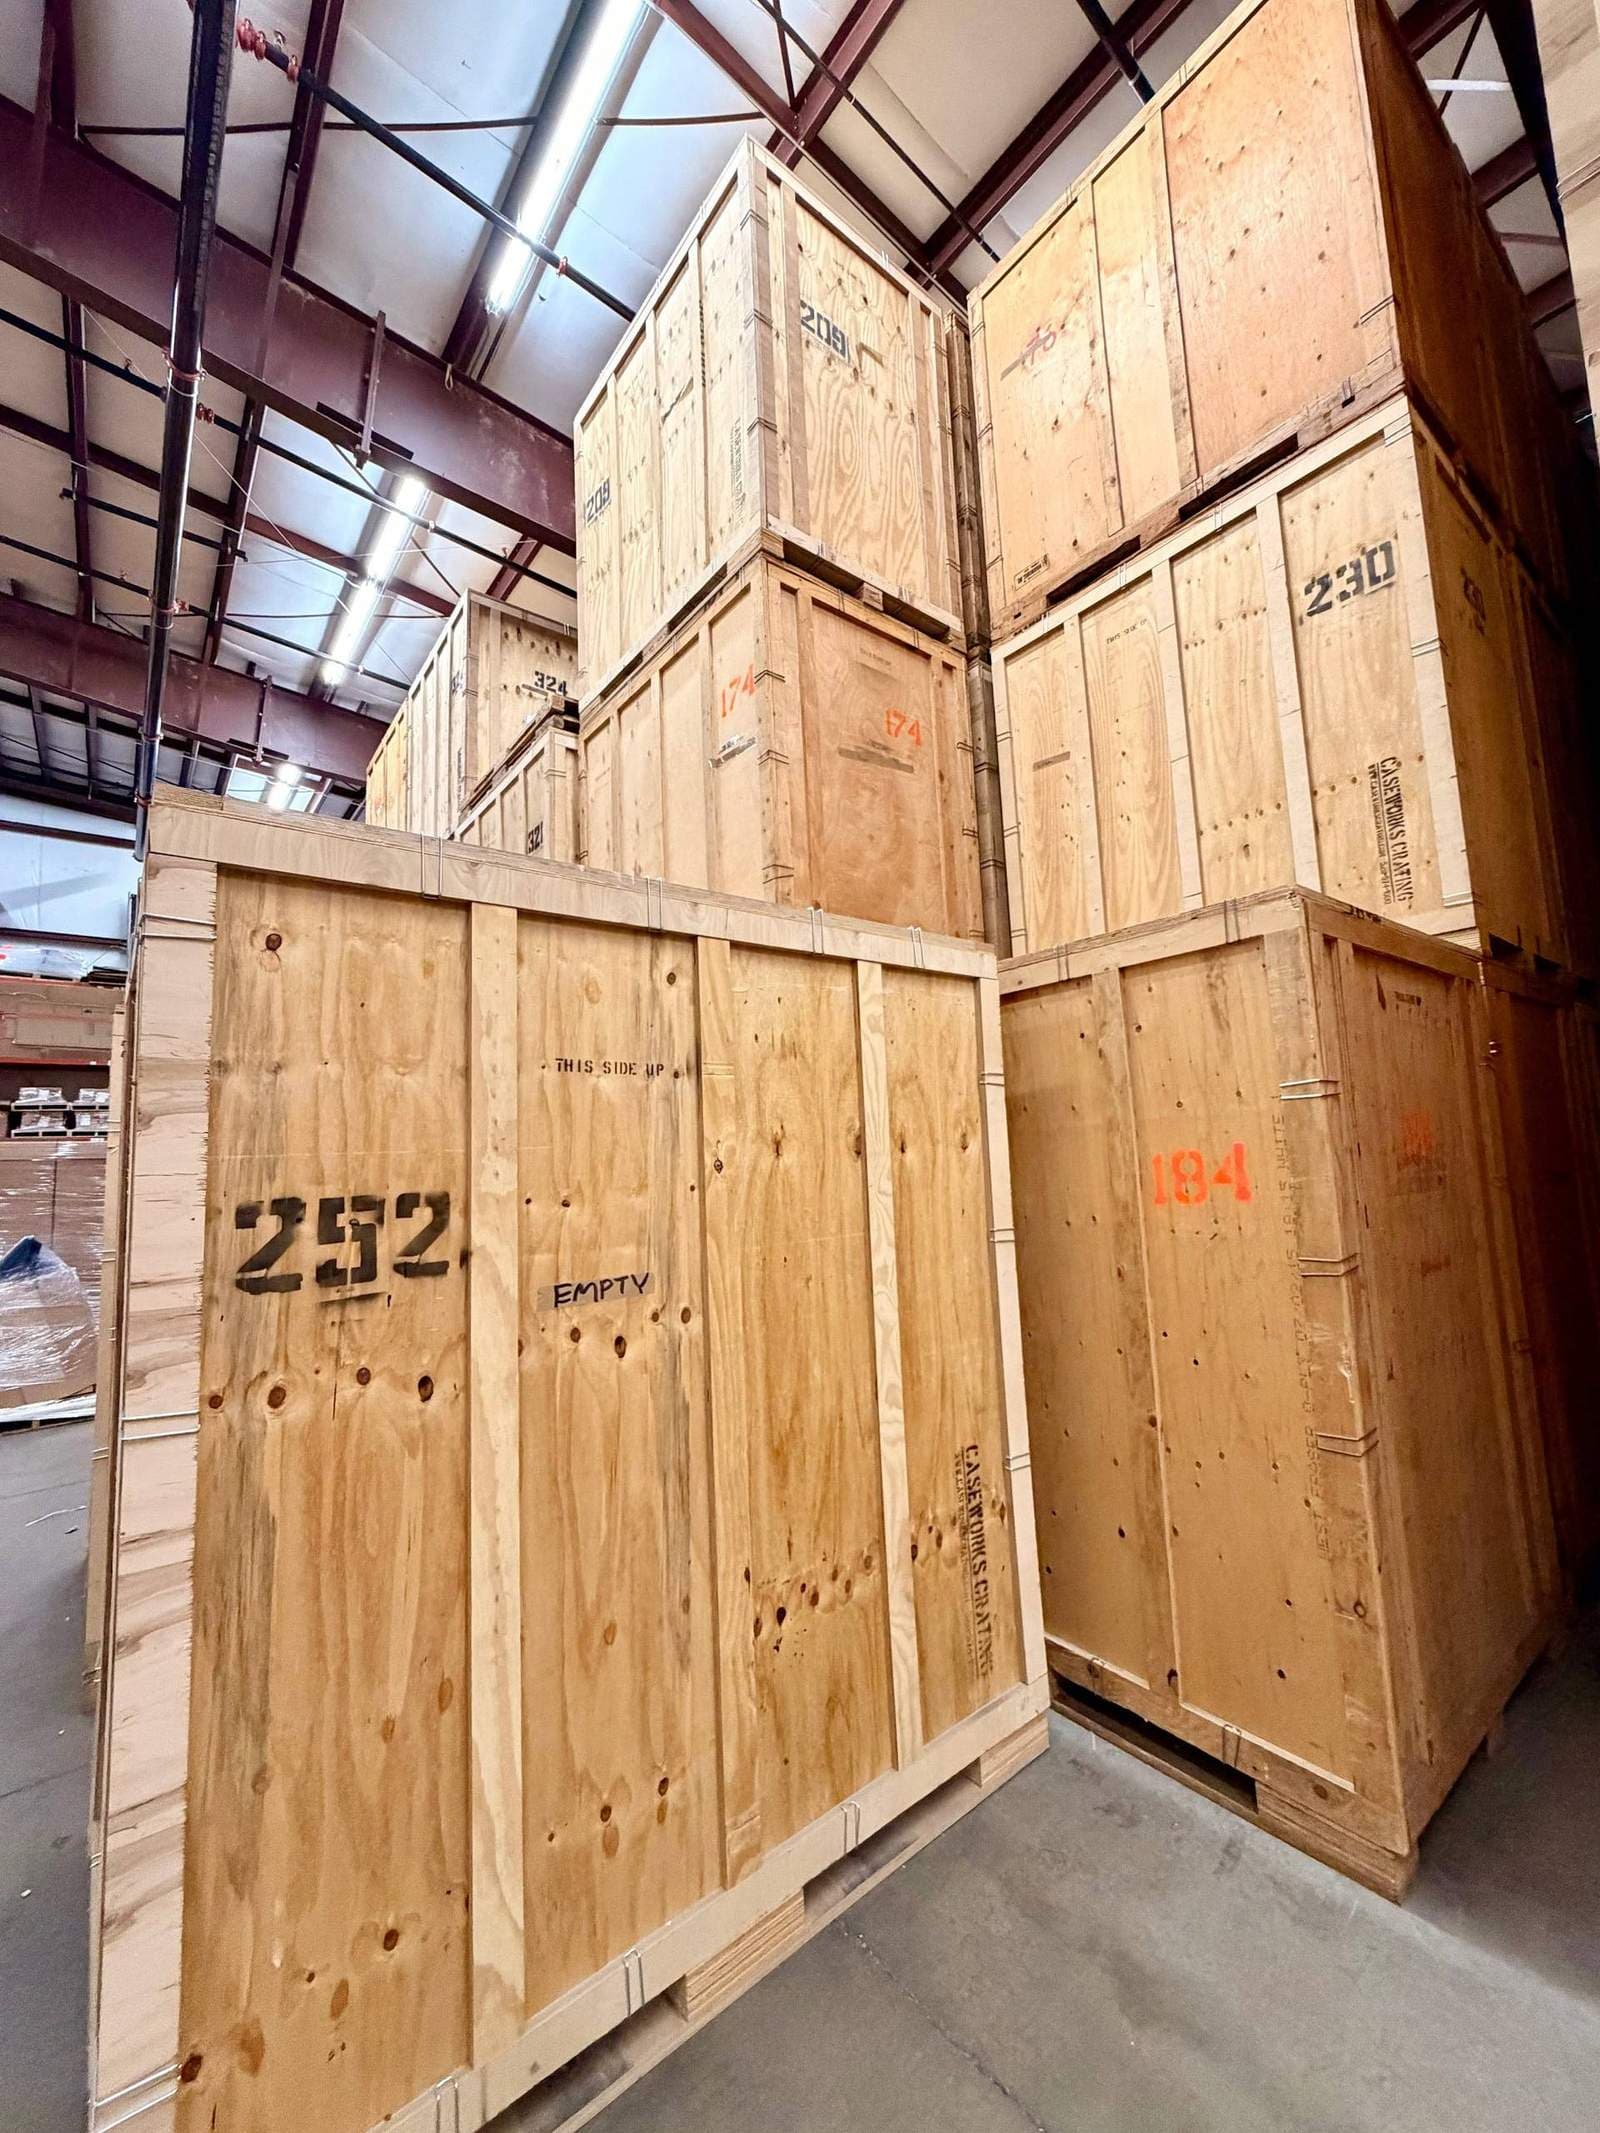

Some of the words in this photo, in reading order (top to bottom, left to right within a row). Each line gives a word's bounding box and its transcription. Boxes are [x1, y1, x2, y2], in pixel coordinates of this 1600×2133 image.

[800, 299, 847, 359] 209
[585, 477, 610, 524] 209
[1303, 540, 1396, 618] 230
[533, 670, 568, 697] 324
[721, 663, 757, 719] 174
[884, 707, 922, 747] 174
[1380, 756, 1406, 841] CASEWORKS
[1391, 841, 1414, 903] CRATING
[555, 1058, 594, 1075] THIS
[602, 1060, 638, 1076] SIDE
[646, 1062, 665, 1077] UP
[1151, 1141, 1253, 1207] 184
[235, 1190, 451, 1296] 252
[553, 1272, 650, 1308] EMPTY
[965, 1444, 988, 1576] CASEWORKS
